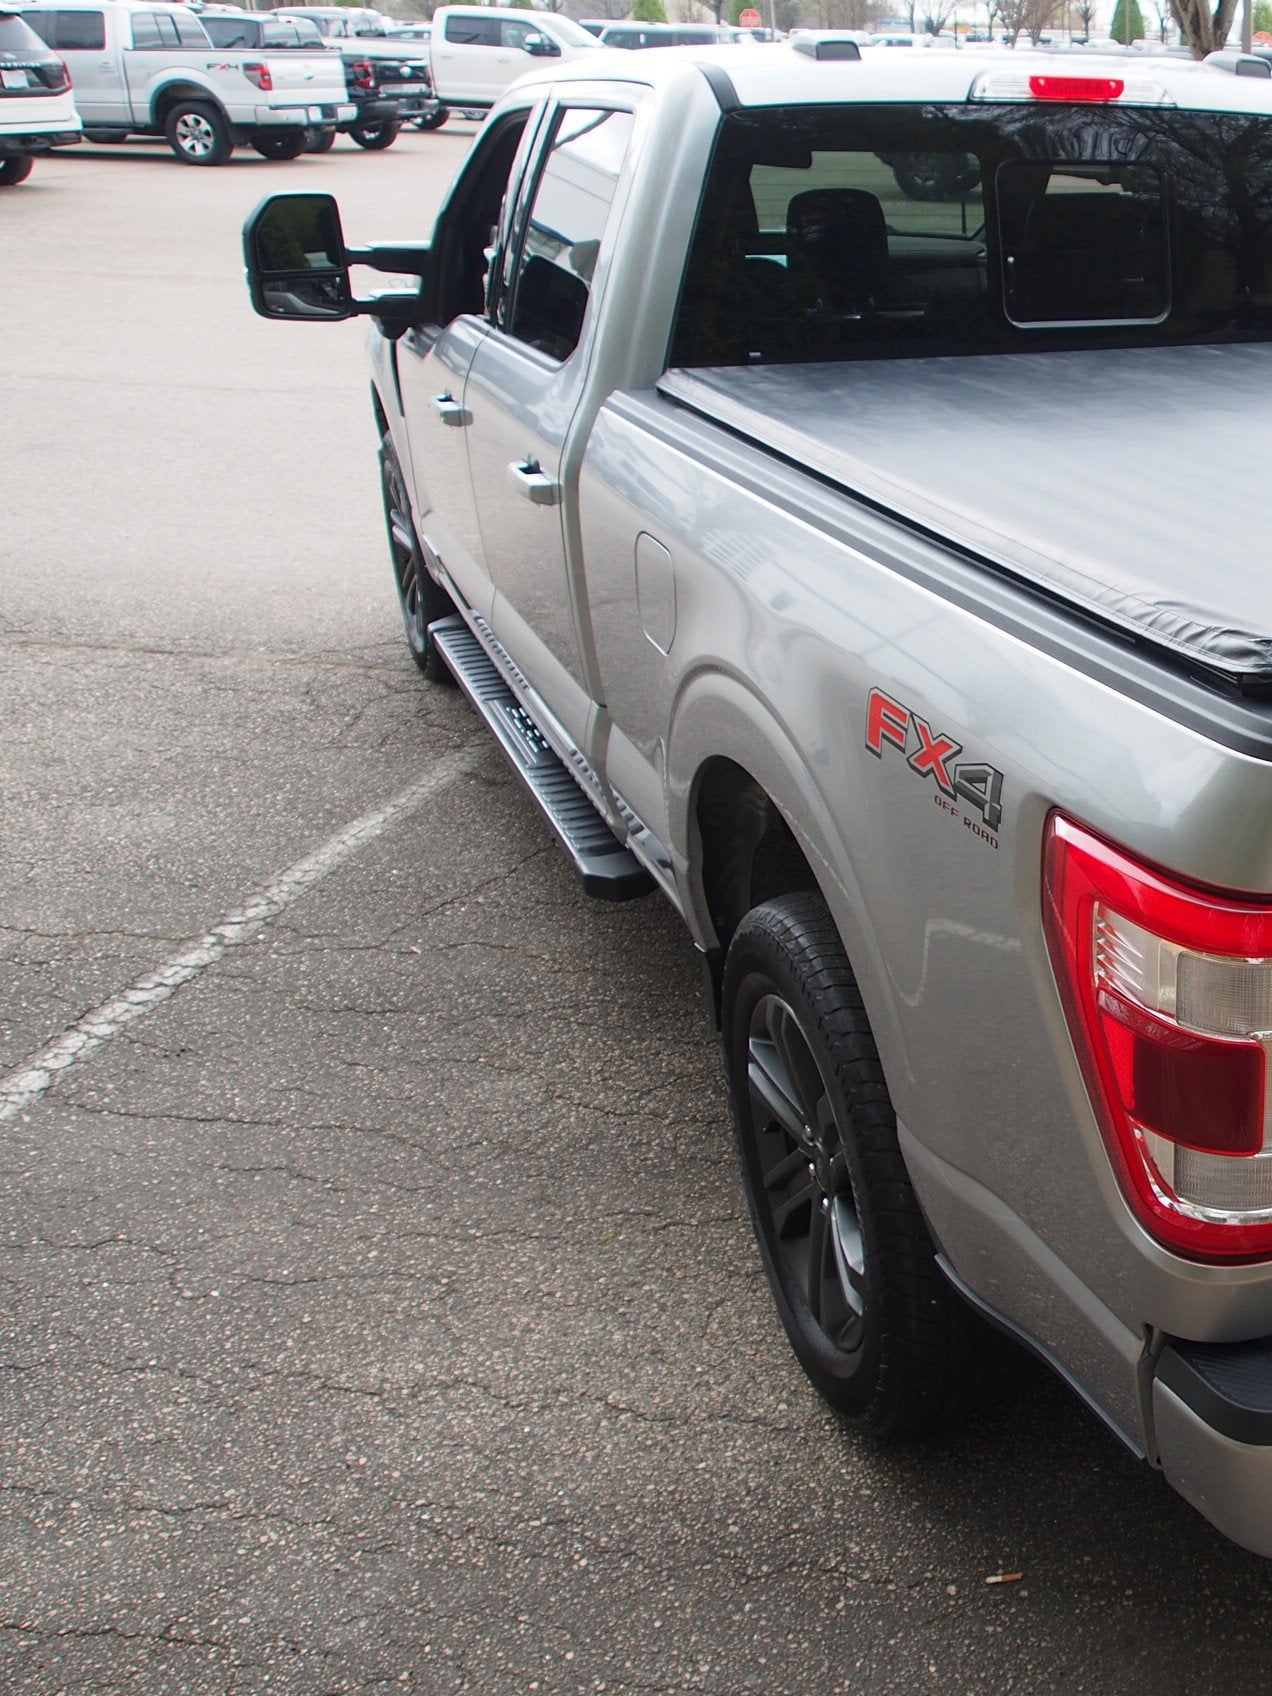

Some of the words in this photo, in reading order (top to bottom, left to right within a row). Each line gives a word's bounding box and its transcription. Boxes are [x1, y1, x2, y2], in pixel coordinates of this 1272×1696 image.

[742, 17, 760, 25] STOP
[865, 686, 1004, 833] FX4
[934, 795, 959, 818] OFF
[963, 816, 998, 850] ROAD
